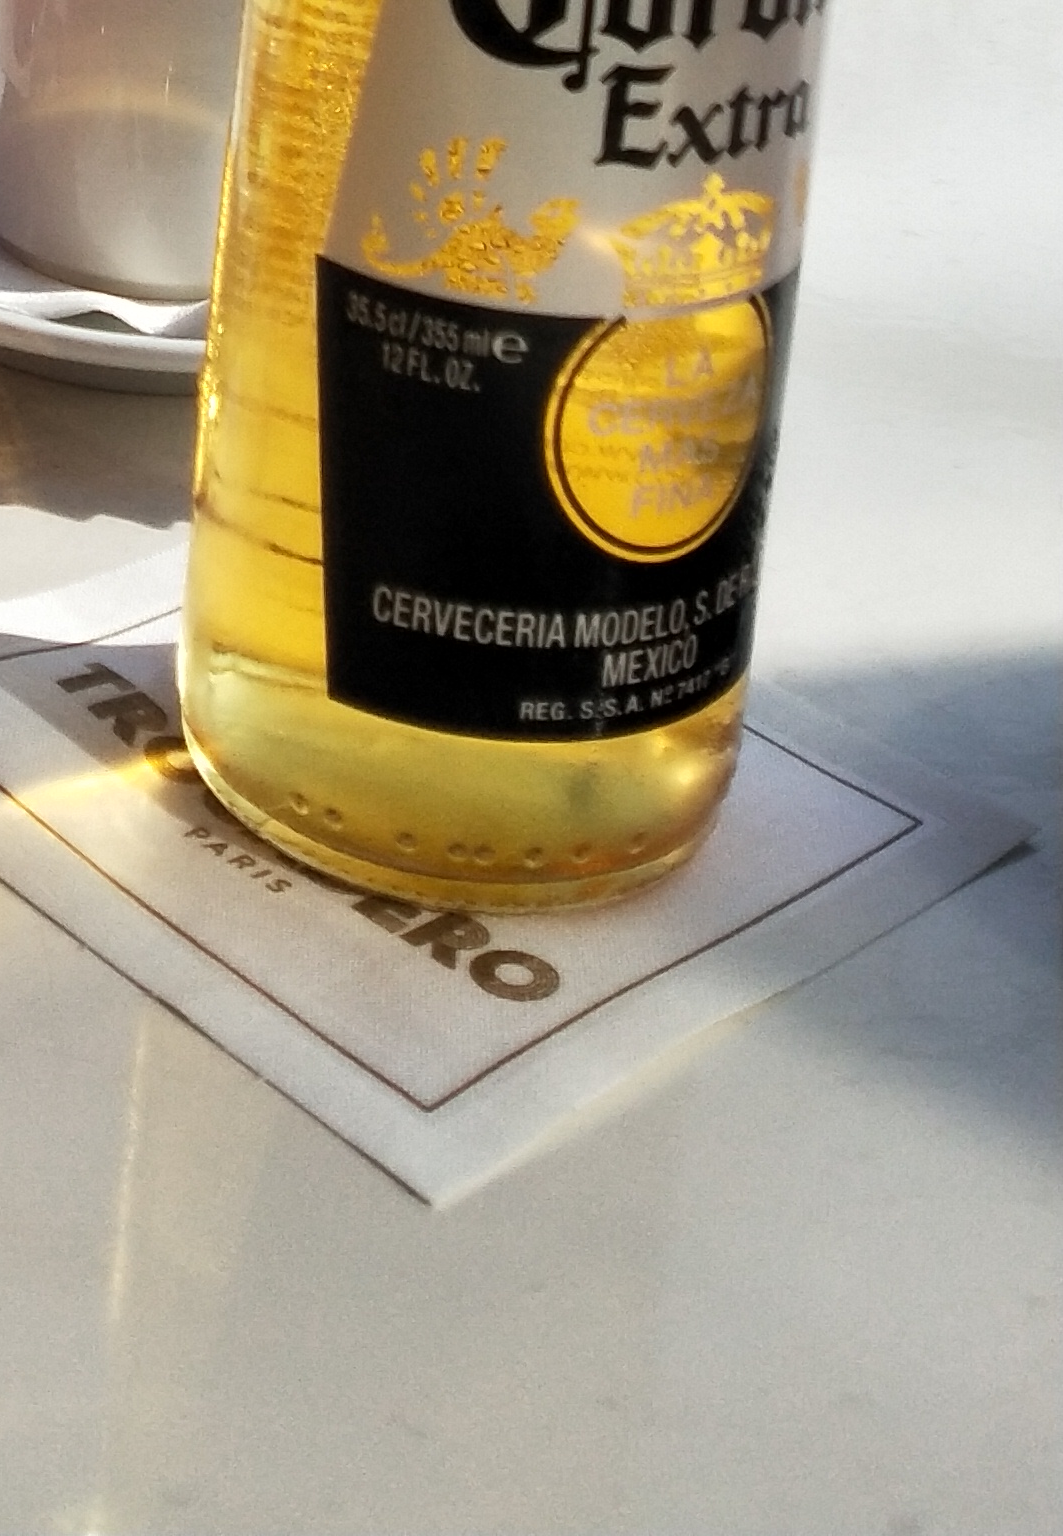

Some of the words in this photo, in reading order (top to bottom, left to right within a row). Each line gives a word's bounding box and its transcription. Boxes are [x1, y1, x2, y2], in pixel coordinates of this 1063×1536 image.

[664, 345, 715, 389] LA
[630, 473, 714, 520] FINA
[372, 585, 566, 649] CERVECERIA
[574, 597, 690, 648] MODELO,
[601, 633, 698, 688] MEXICO
[519, 701, 573, 721] REG.
[184, 827, 293, 893] PARIS
